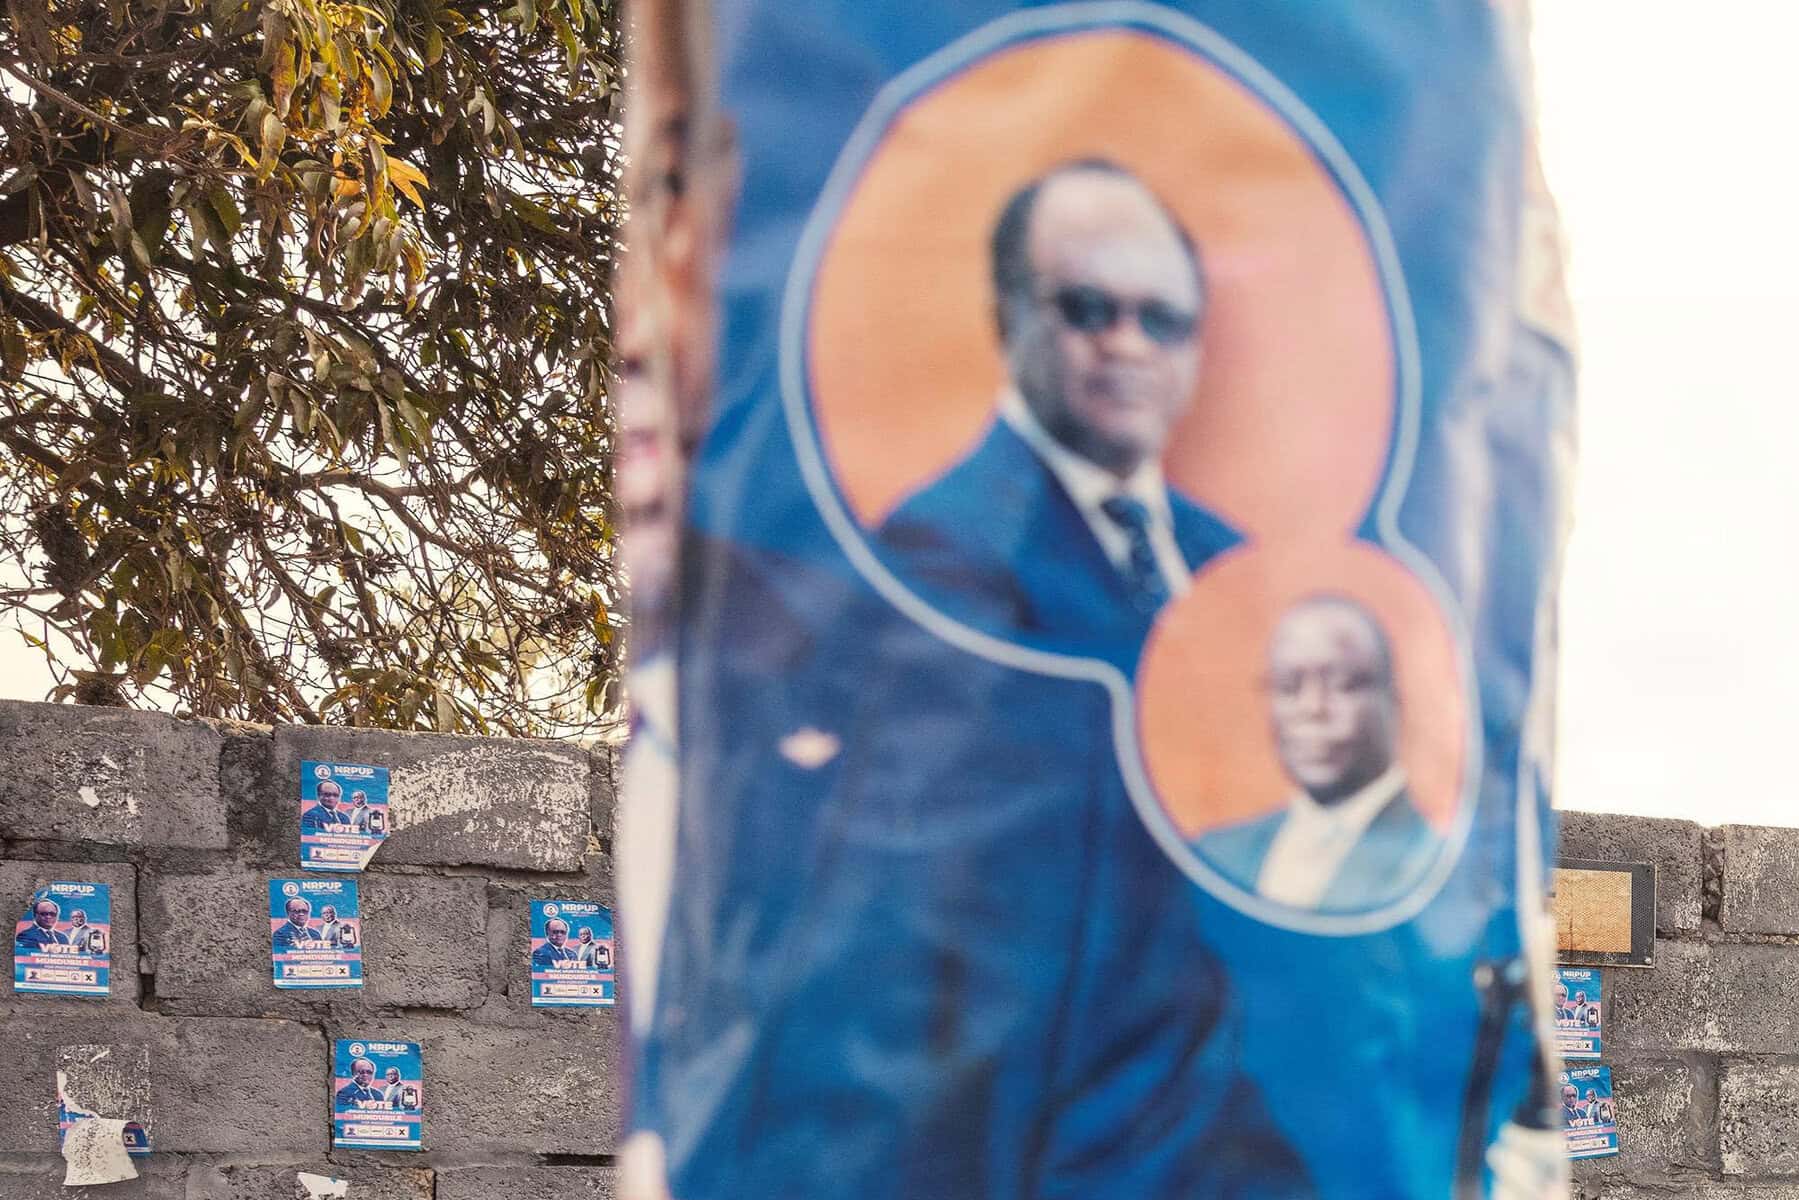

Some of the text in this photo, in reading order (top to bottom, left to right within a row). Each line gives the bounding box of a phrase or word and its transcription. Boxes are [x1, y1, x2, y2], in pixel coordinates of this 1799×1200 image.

[334, 766, 374, 775] NRPUP
[323, 824, 360, 832] VOTE
[51, 884, 95, 893] NRPUP
[303, 882, 342, 890] NRPUP
[562, 903, 599, 912] NRPUP
[40, 944, 79, 953] VOTE
[294, 940, 331, 949] VOTE
[552, 960, 587, 969] VOTE
[368, 1043, 408, 1052] NRPUP
[1571, 1069, 1600, 1077] NRPUP
[357, 1101, 393, 1110] VOTE
[1569, 1118, 1595, 1127] VOTE
